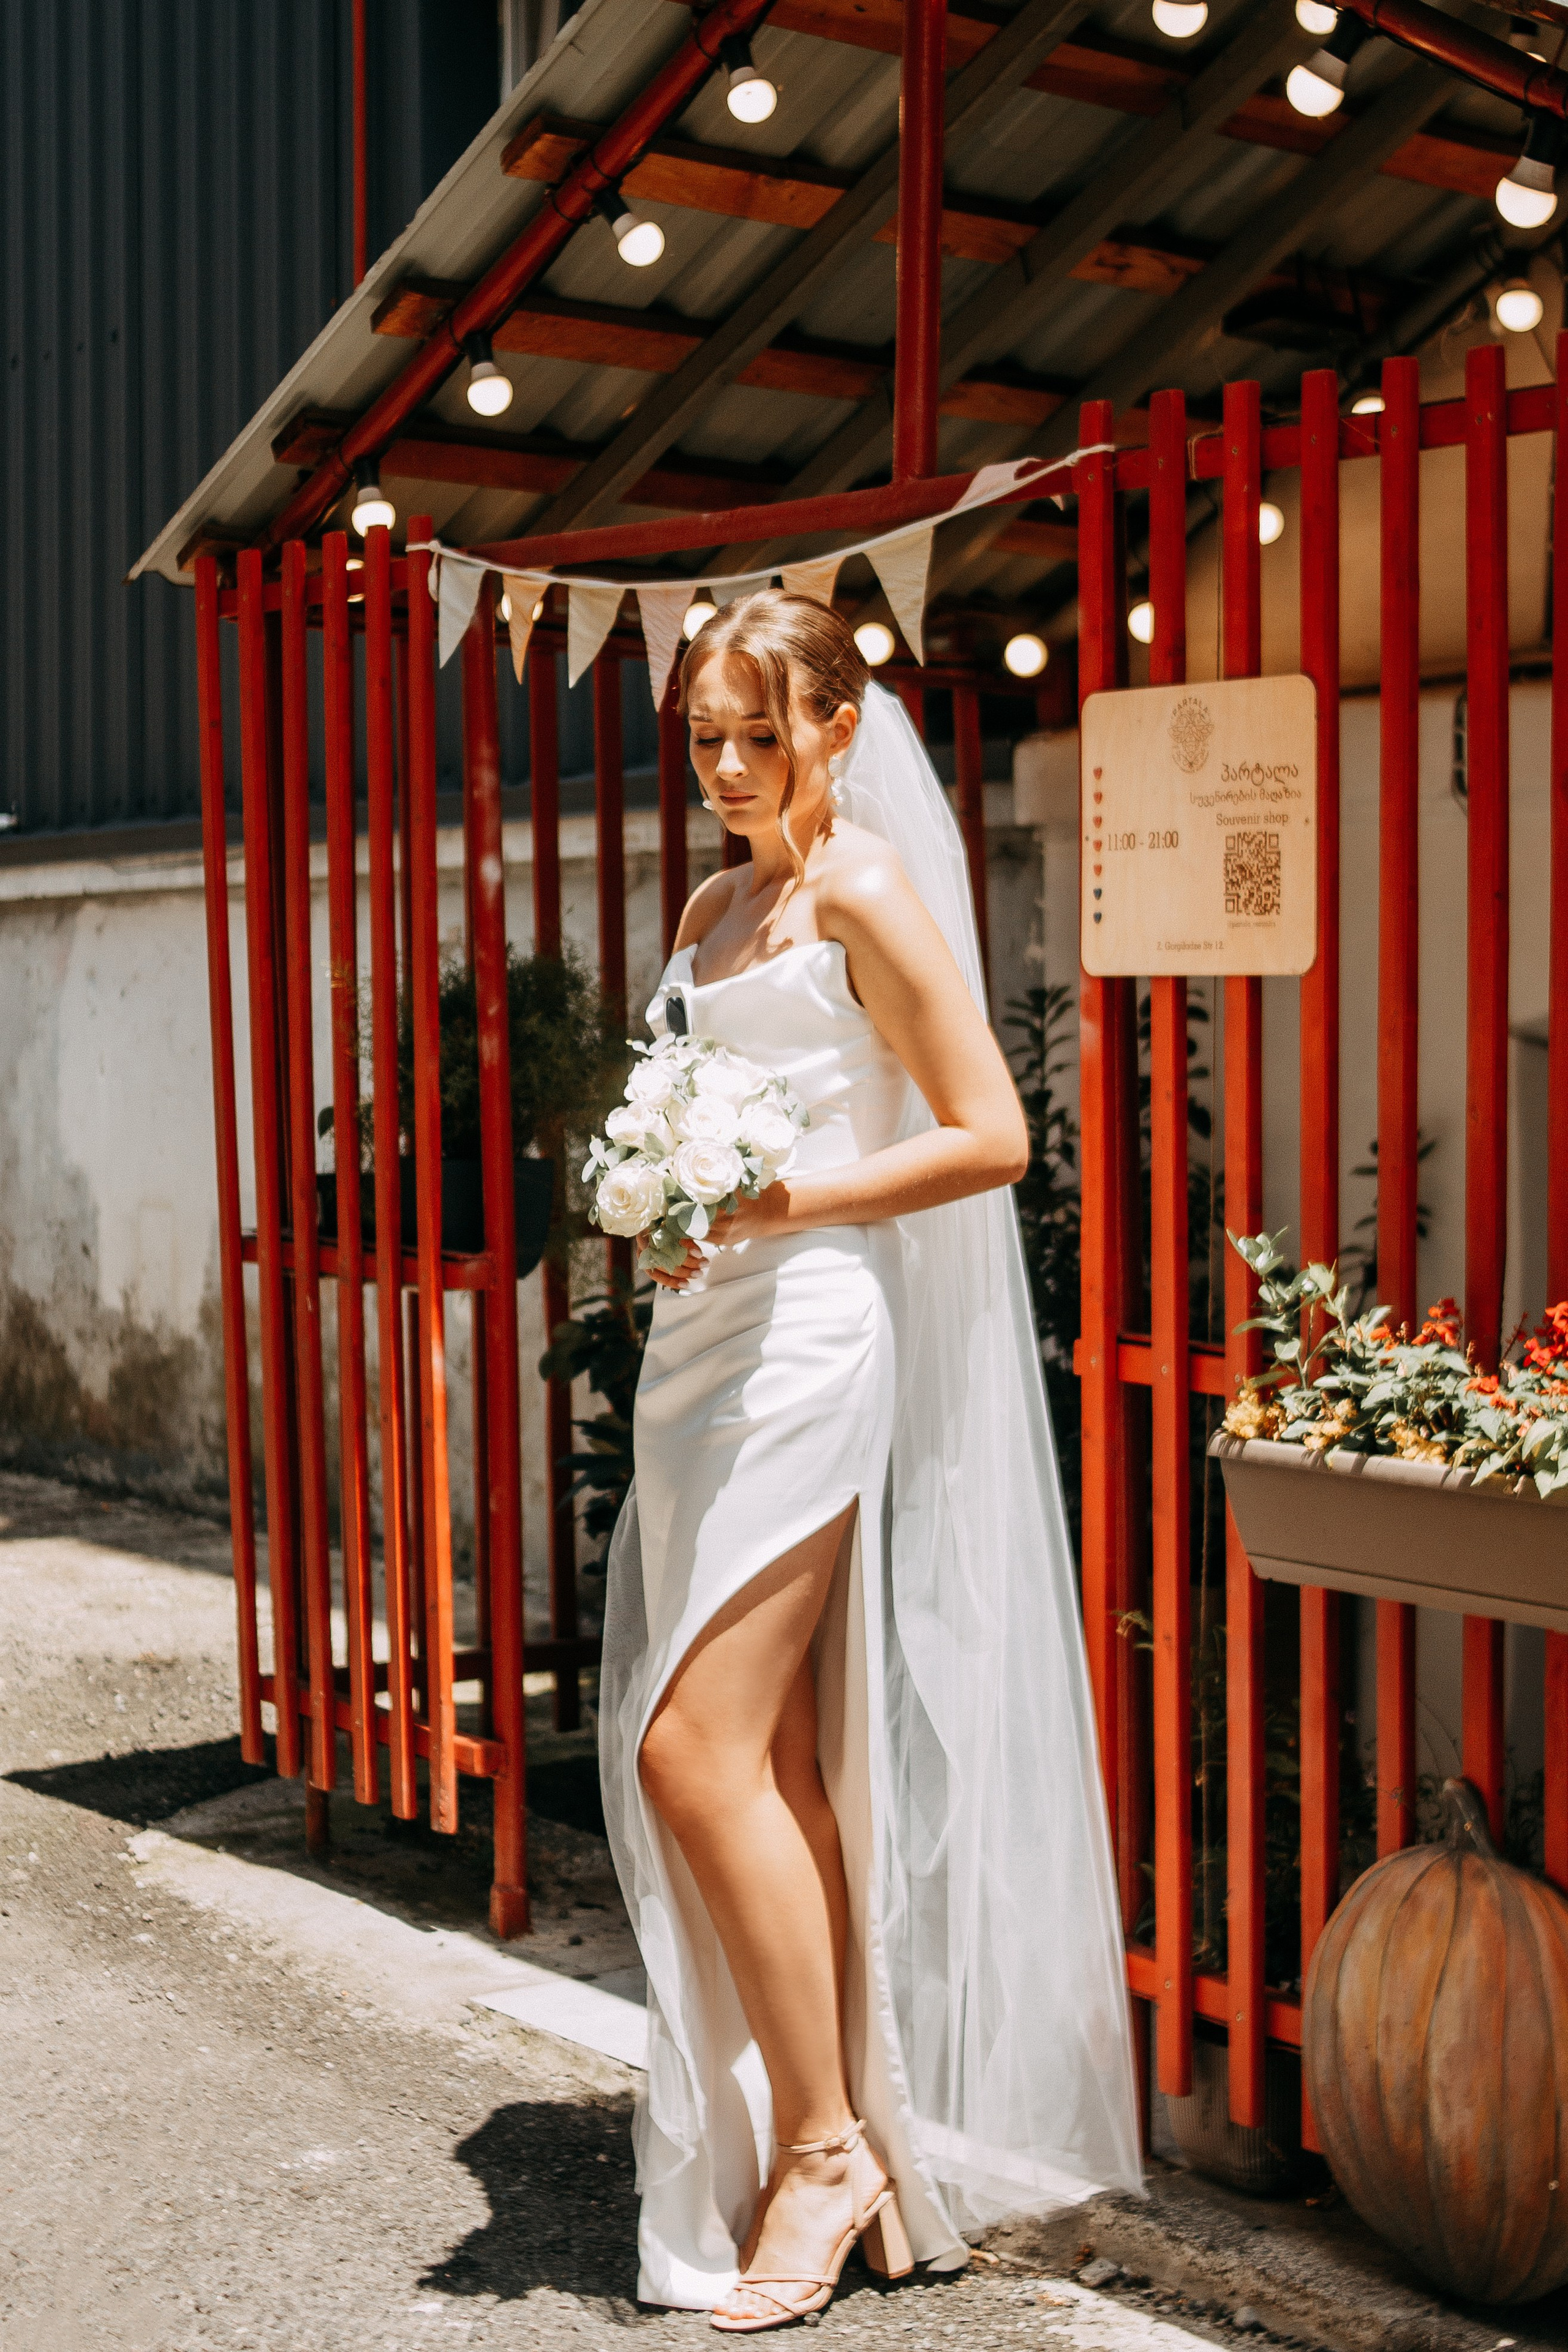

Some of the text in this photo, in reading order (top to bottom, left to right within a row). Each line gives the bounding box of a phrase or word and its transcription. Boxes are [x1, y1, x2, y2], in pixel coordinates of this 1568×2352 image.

[1172, 697, 1208, 717] PARTALA
[1221, 761, 1298, 786] პარტალა
[1216, 810, 1289, 826] Souvenir shop
[1107, 832, 1136, 851] 11:00
[1148, 831, 1178, 849] 21:00
